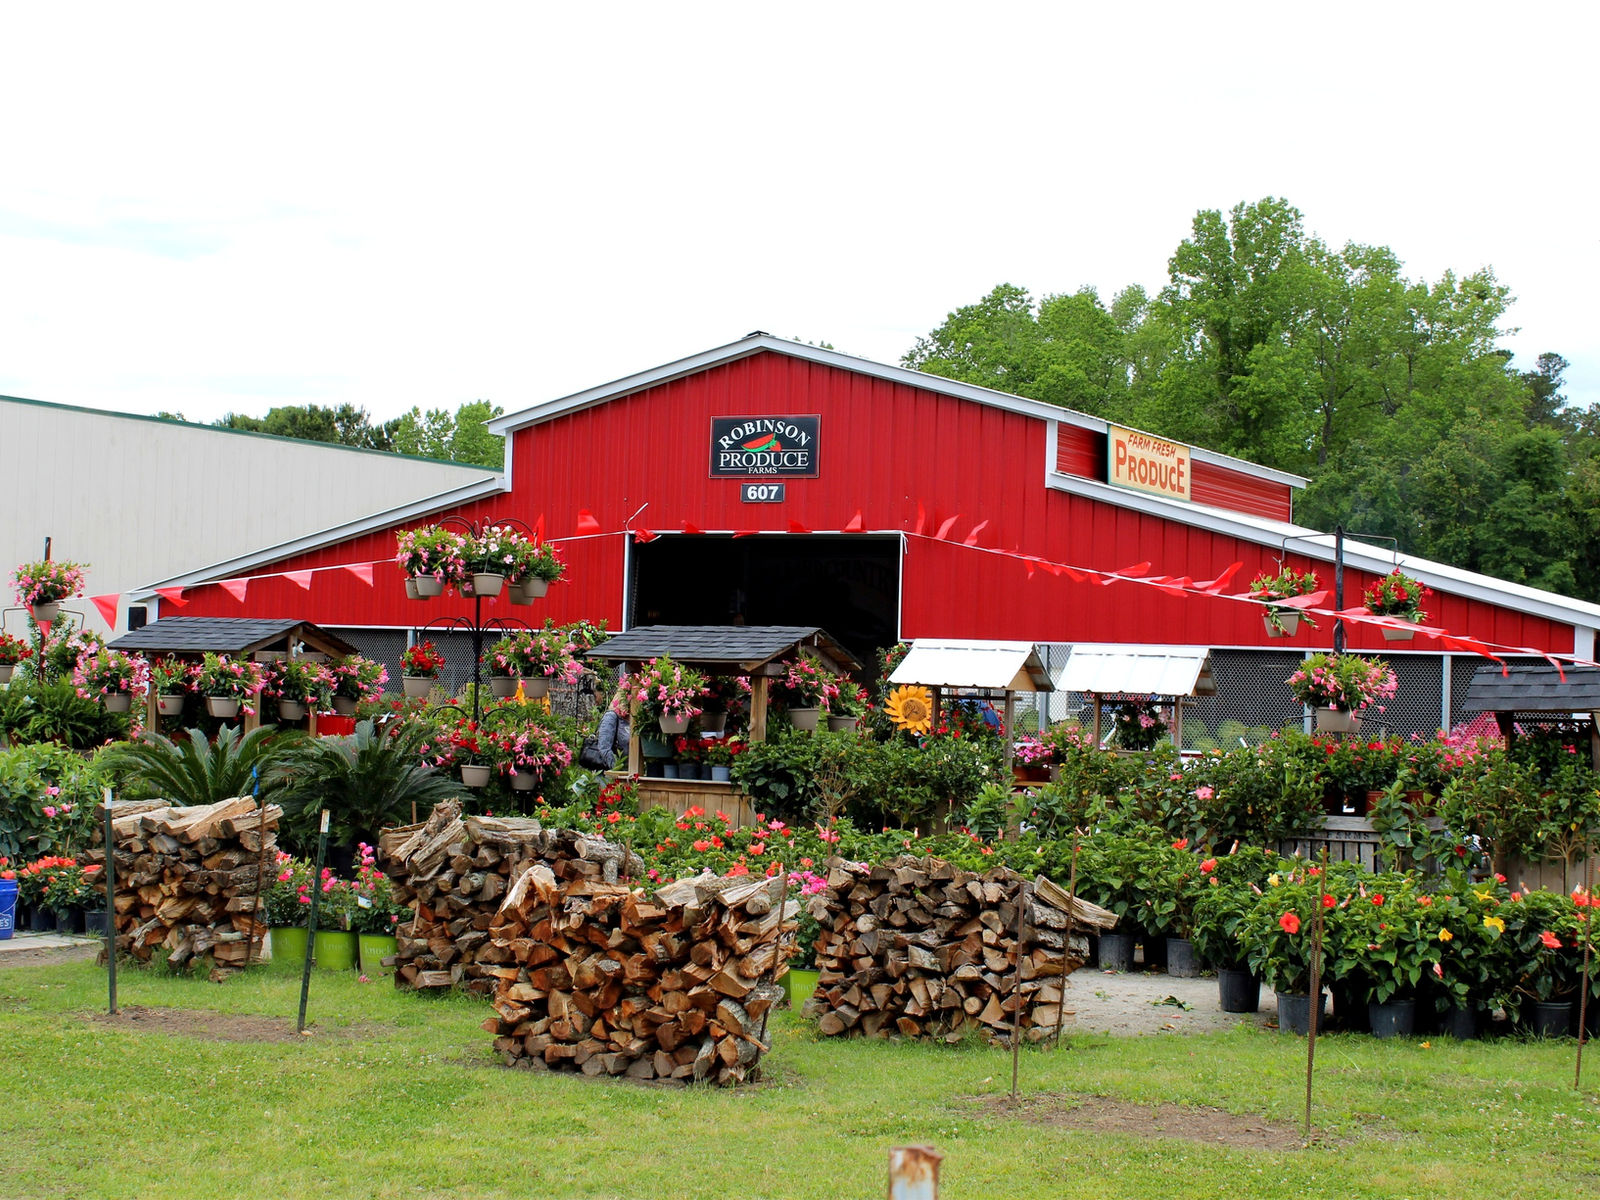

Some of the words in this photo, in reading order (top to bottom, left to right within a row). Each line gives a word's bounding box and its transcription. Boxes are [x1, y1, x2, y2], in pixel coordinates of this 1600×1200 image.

[718, 420, 811, 449] ROBINSON
[1128, 433, 1151, 452] FARM
[1152, 440, 1176, 458] FRESH
[719, 452, 809, 467] PRODUCE
[1116, 439, 1185, 493] PRODUCE
[748, 466, 778, 475] FARMS
[747, 485, 779, 500] 607
